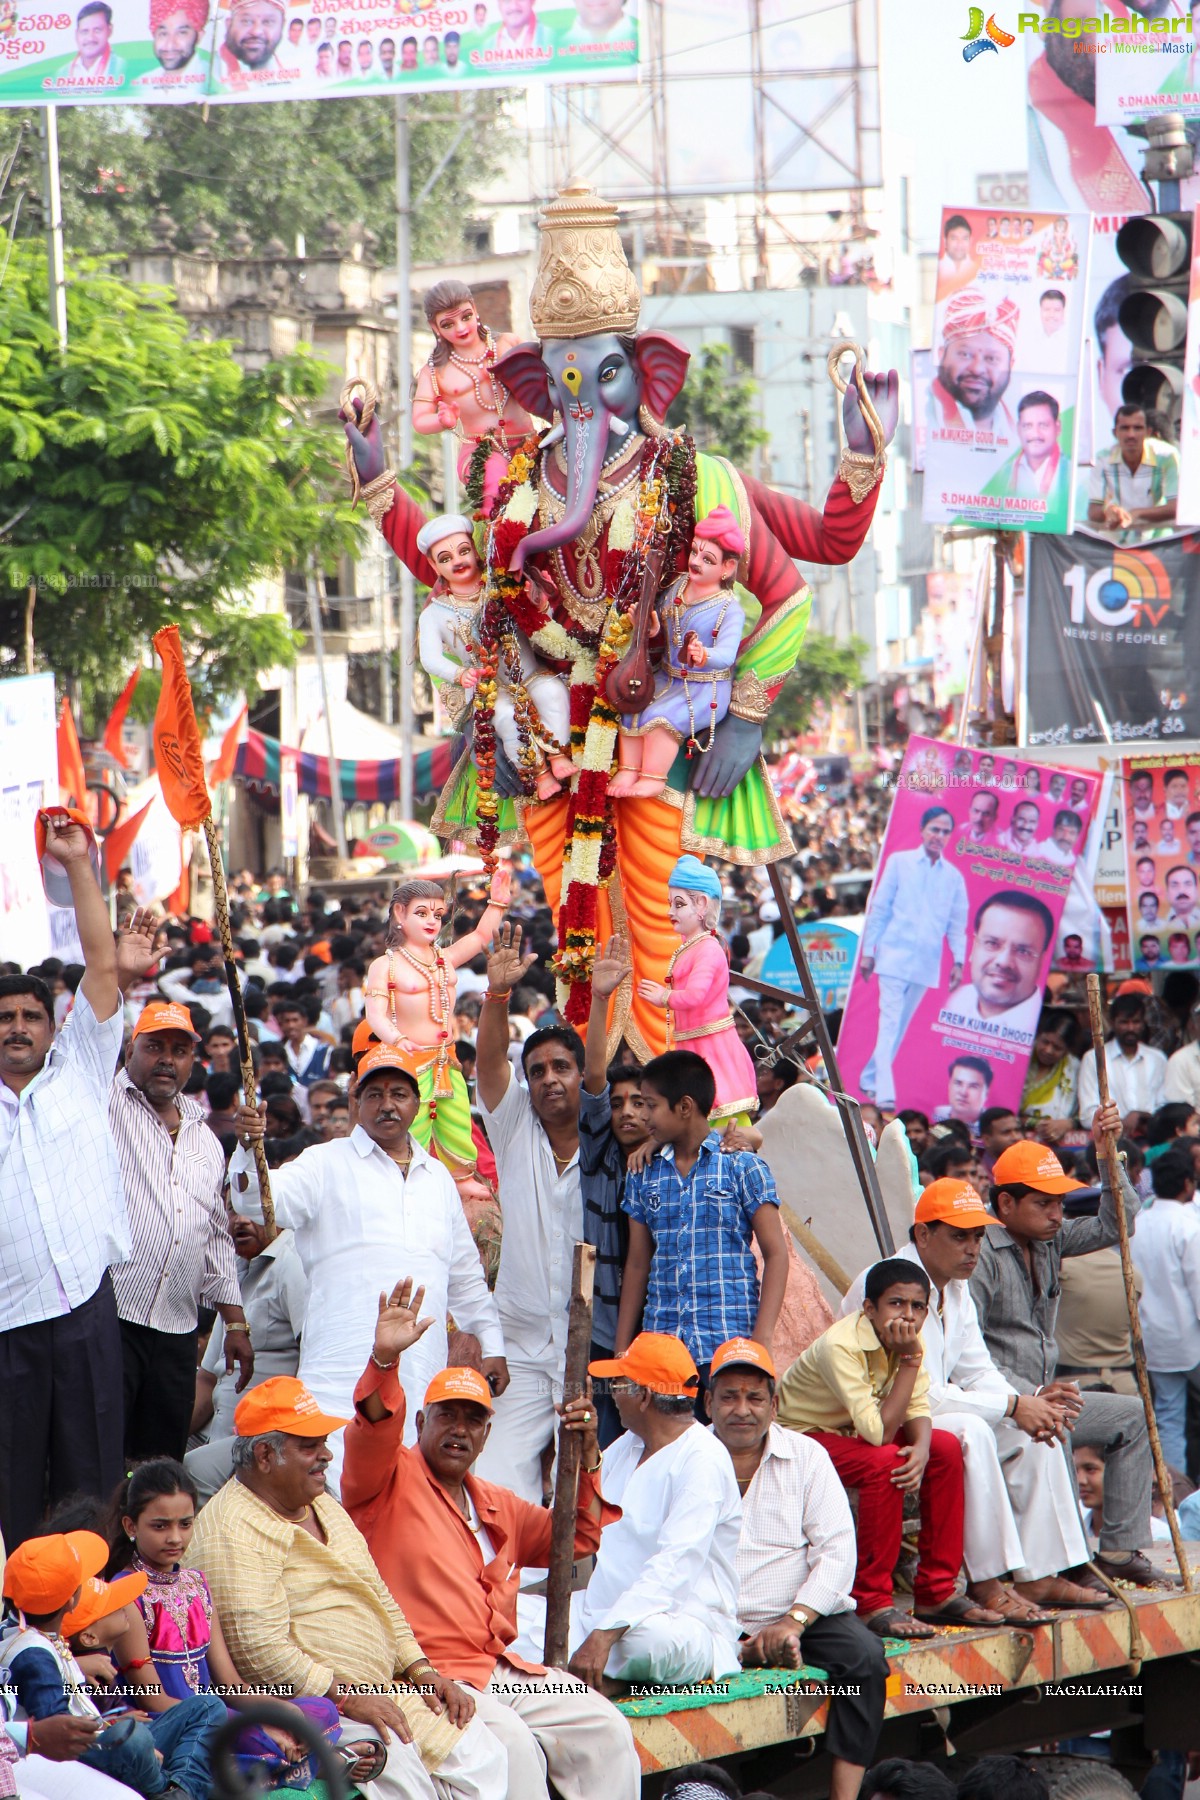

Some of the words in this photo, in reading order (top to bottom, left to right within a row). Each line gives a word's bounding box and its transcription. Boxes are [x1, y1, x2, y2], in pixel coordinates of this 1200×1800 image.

[1118, 94, 1179, 108] S.DHANRAJ
[975, 431, 994, 445] GOUD
[941, 493, 1001, 508] S.DHANRAJ
[1004, 498, 1047, 512] MADIGA
[1063, 627, 1097, 641] NEWS
[1101, 629, 1112, 642] IS
[1116, 629, 1167, 645] PEOPLE
[940, 1010, 966, 1025] PREM
[967, 1016, 1000, 1035] KUMAR
[1000, 1026, 1034, 1044] DHOOT
